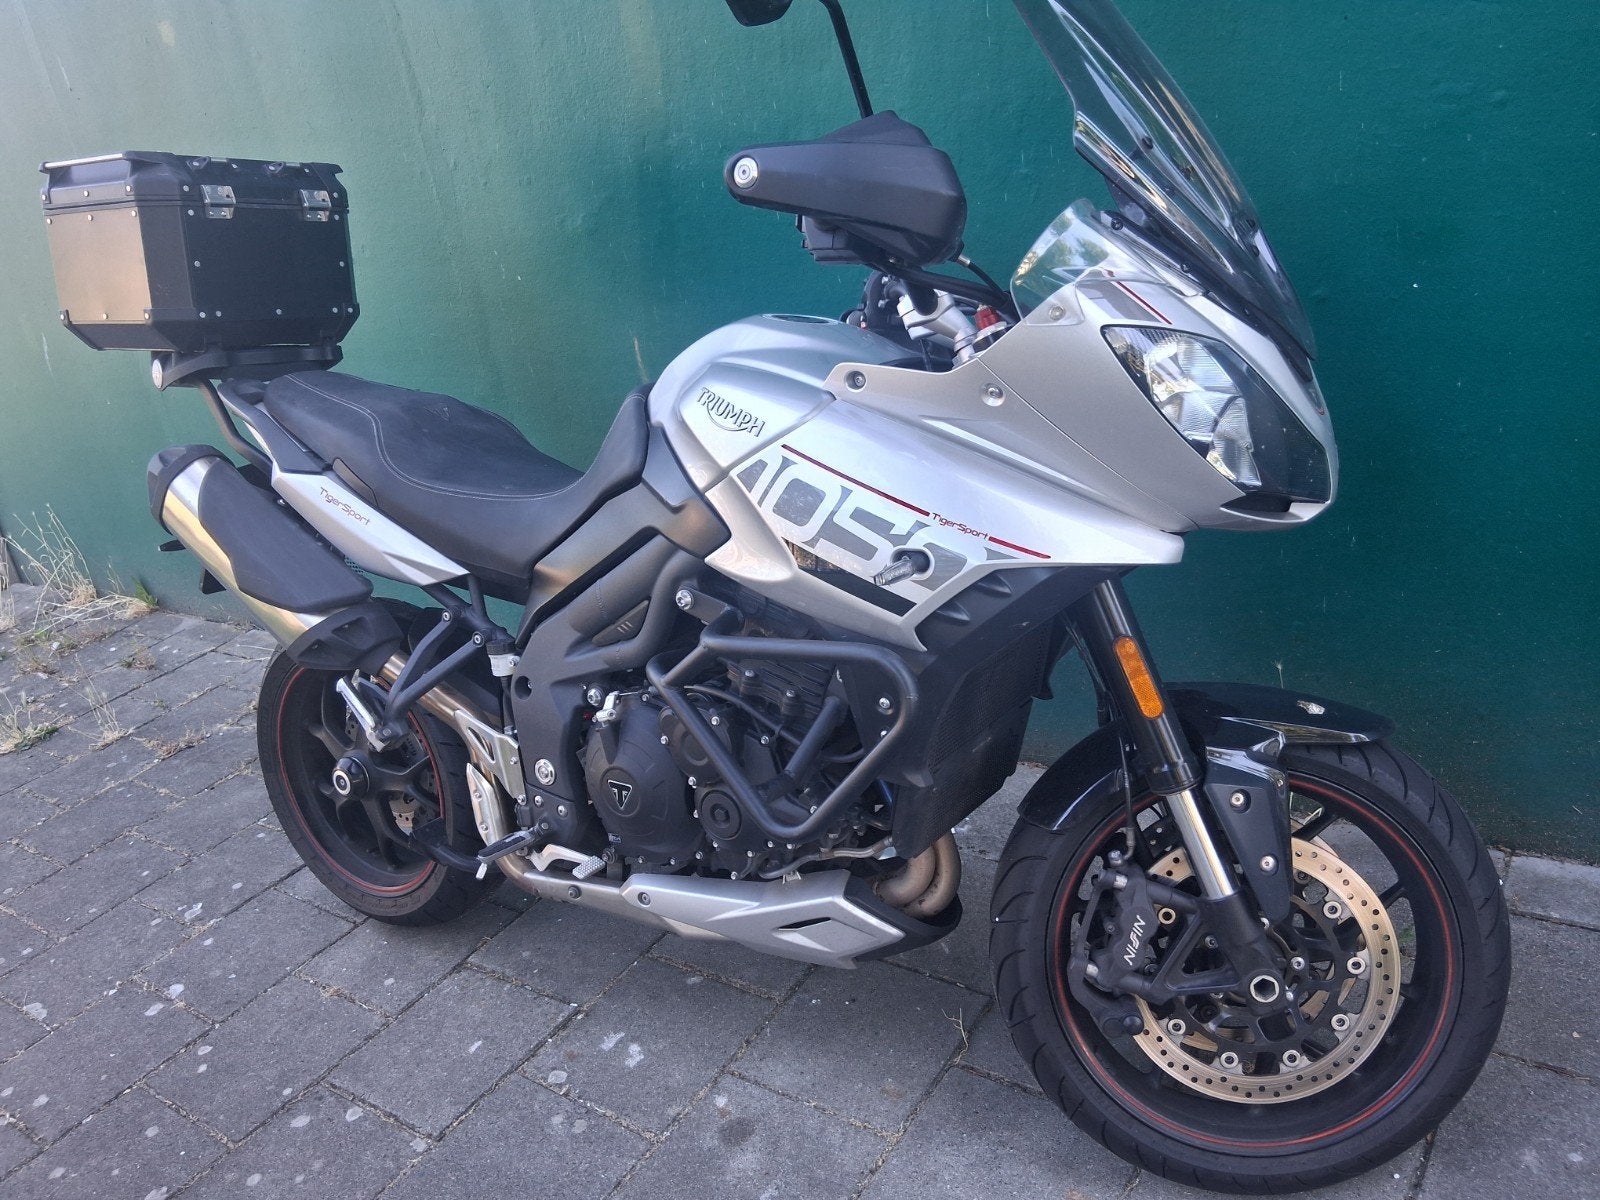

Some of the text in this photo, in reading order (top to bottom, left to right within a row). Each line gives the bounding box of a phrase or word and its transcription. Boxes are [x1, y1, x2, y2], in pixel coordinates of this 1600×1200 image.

[697, 386, 766, 438] TRIUMPH
[320, 486, 371, 526] TigerSport
[932, 512, 988, 540] TigerSport
